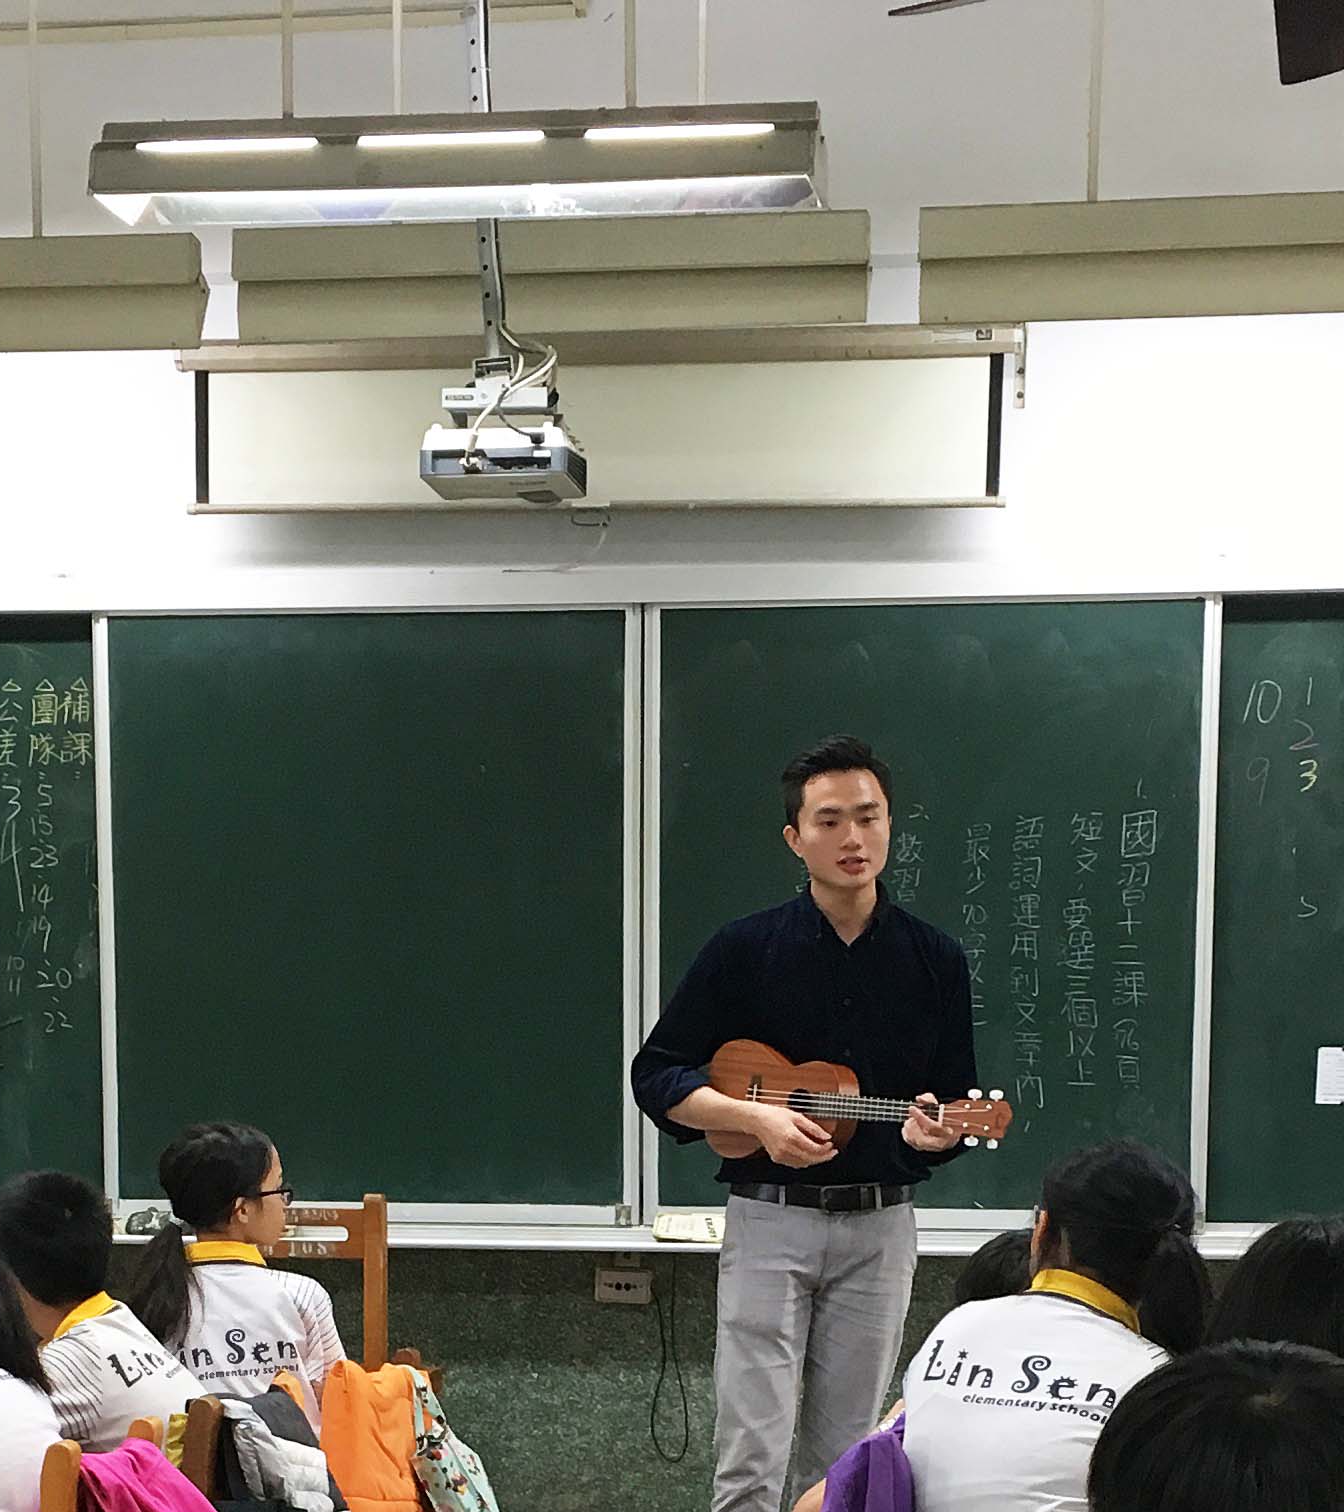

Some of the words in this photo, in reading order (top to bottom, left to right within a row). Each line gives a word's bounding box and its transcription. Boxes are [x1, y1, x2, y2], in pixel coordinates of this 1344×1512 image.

[1242, 680, 1282, 724] 10
[1299, 759, 1318, 793] 3
[225, 1328, 298, 1365] Sen
[198, 1367, 262, 1381] elementary
[923, 1339, 994, 1389] Lin
[1011, 1354, 1117, 1409] Sen
[962, 1393, 1047, 1412] elementary
[1049, 1402, 1108, 1425] school
